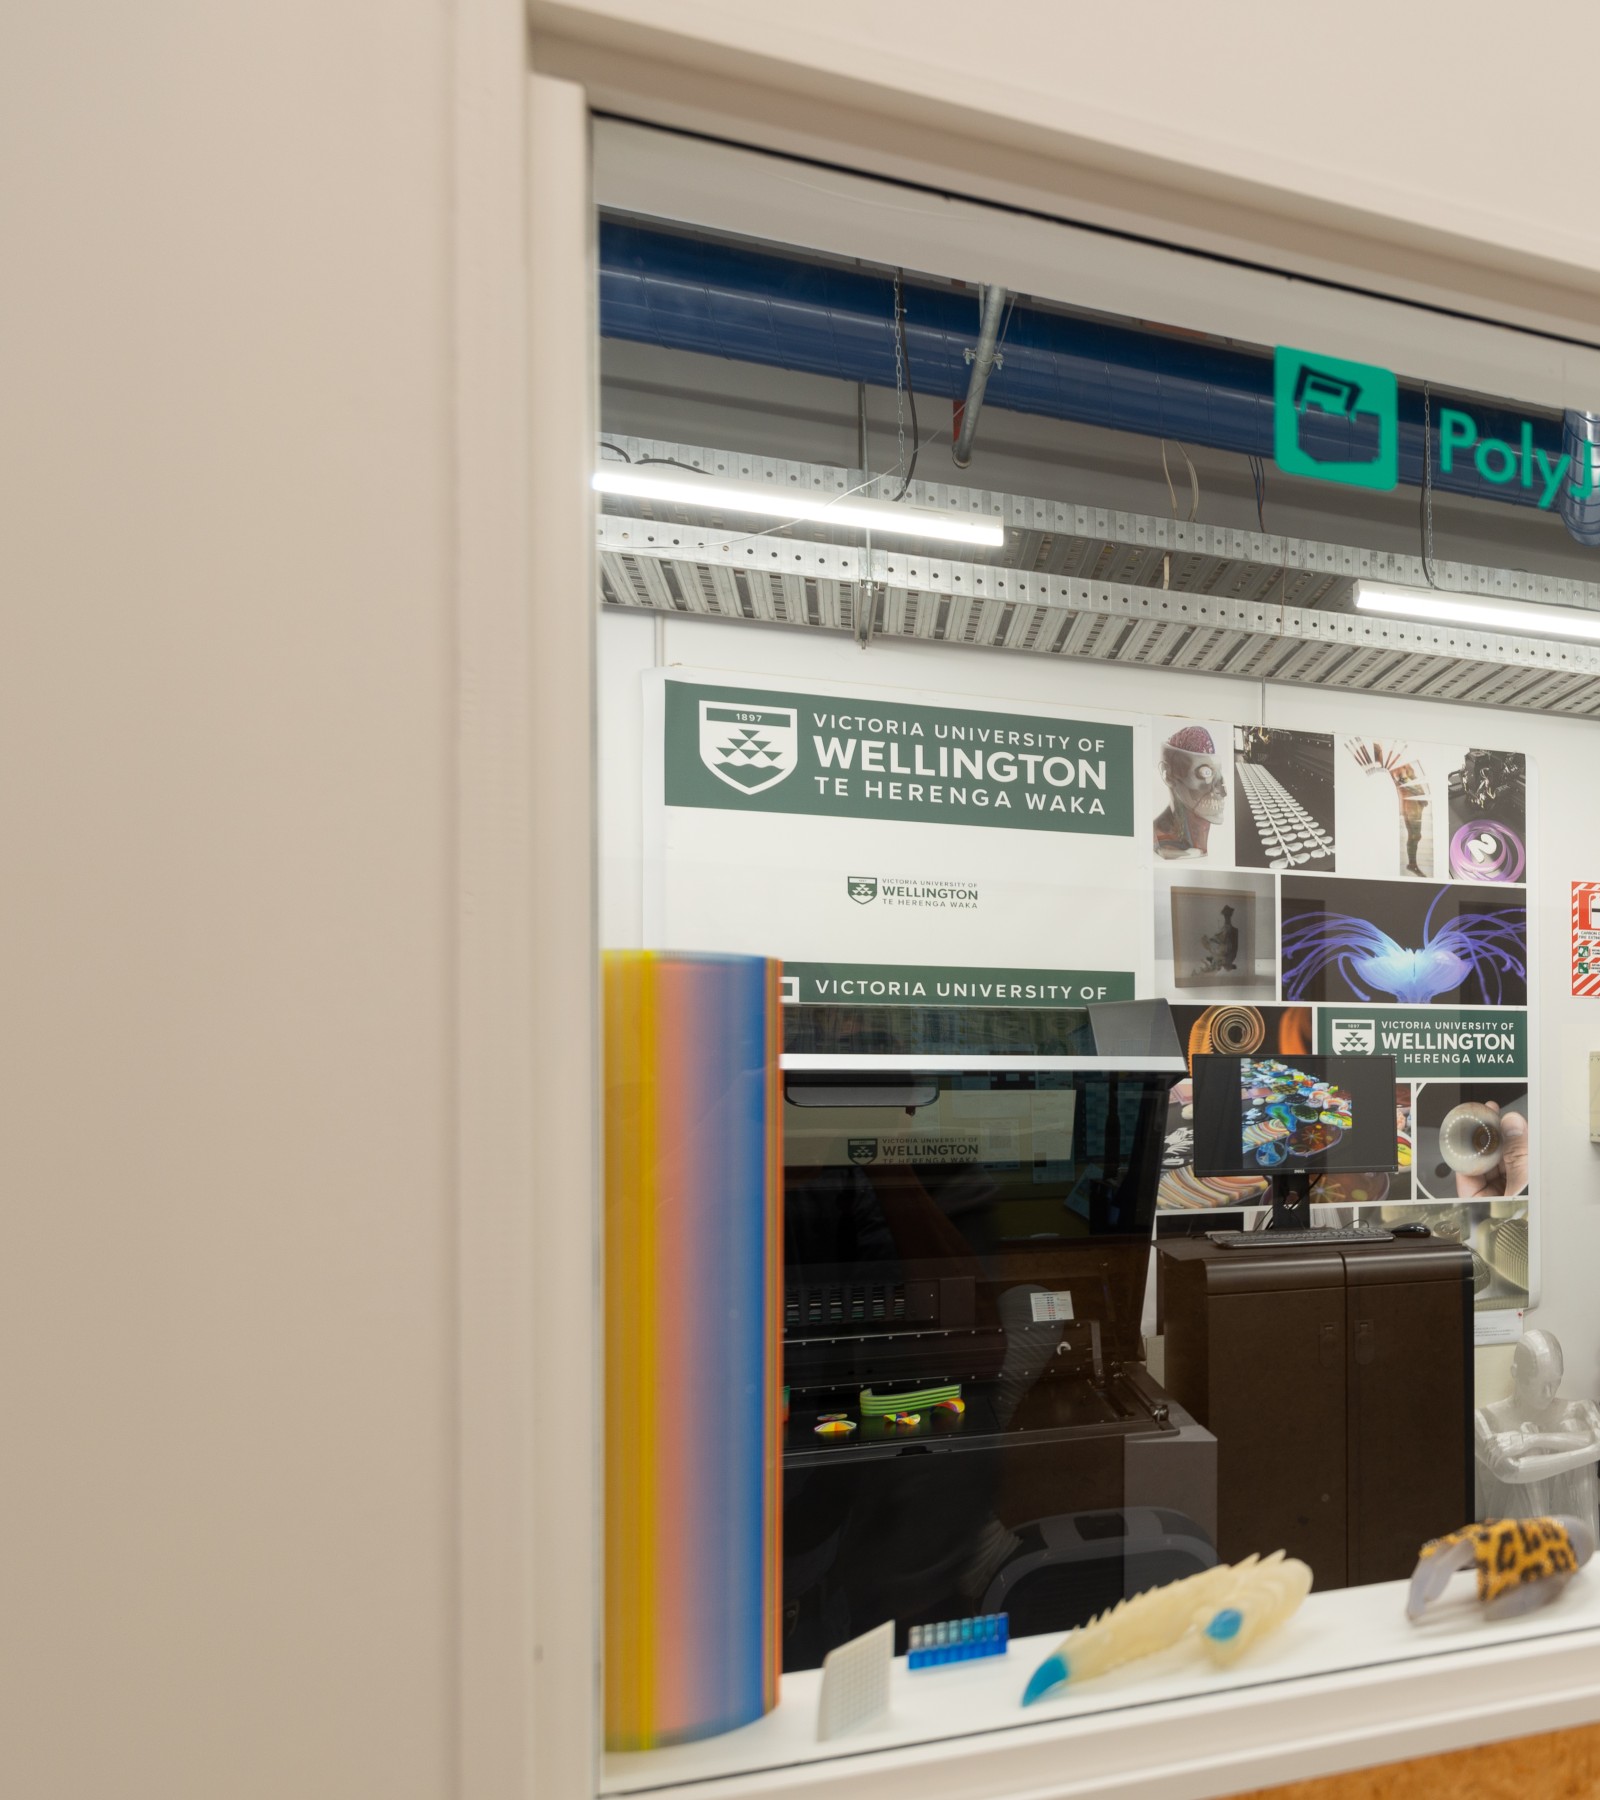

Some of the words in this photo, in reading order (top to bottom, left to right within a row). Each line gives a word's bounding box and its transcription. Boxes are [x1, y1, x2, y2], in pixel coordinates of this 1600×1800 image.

[736, 713, 762, 722] 1897
[813, 713, 924, 737] VICTORIA
[935, 724, 1070, 750] UNIVERSITY
[1078, 738, 1105, 752] OF
[813, 735, 1106, 790] WELLINGTON
[814, 776, 849, 796] TE
[865, 780, 1012, 808] HERENGA
[1025, 792, 1106, 815] WAKA
[920, 880, 965, 888] UNIVERSITY
[882, 886, 978, 900] WELLINGTON
[815, 979, 927, 997] VICTORIA
[936, 982, 1072, 999] UNIVERSITY
[1079, 985, 1107, 1000] OF
[1381, 1021, 1431, 1030] VICTORIA
[1435, 1022, 1498, 1030] UNIVERSITY
[1500, 1022, 1514, 1030] OF
[1381, 1032, 1515, 1050] WELLINGTON
[1404, 1054, 1471, 1064] HERENGA
[1476, 1054, 1515, 1064] WAKA
[882, 1145, 979, 1156] WELLINGTON
